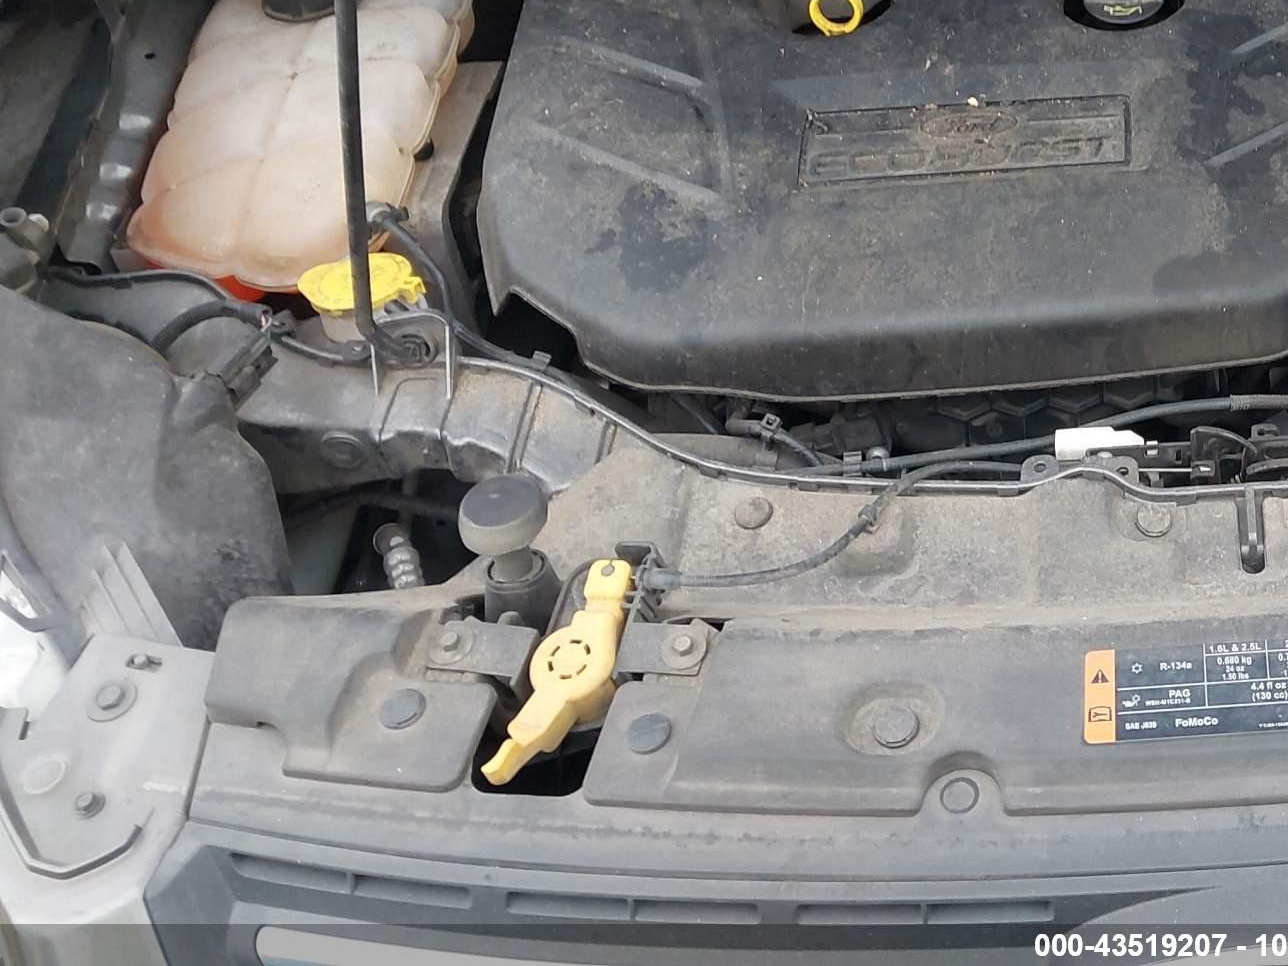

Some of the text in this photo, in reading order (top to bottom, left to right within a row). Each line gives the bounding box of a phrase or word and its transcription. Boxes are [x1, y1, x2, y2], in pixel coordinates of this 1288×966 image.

[1231, 643, 1239, 652] &
[1241, 642, 1262, 651] 2.5L
[1241, 656, 1252, 665] kg
[1159, 661, 1193, 671] R-134a
[1250, 681, 1287, 691] 4.4 fl oz
[1168, 688, 1191, 699] PAG
[1251, 690, 1288, 702] (130 cc)
[1174, 716, 1219, 728] FoMoCo
